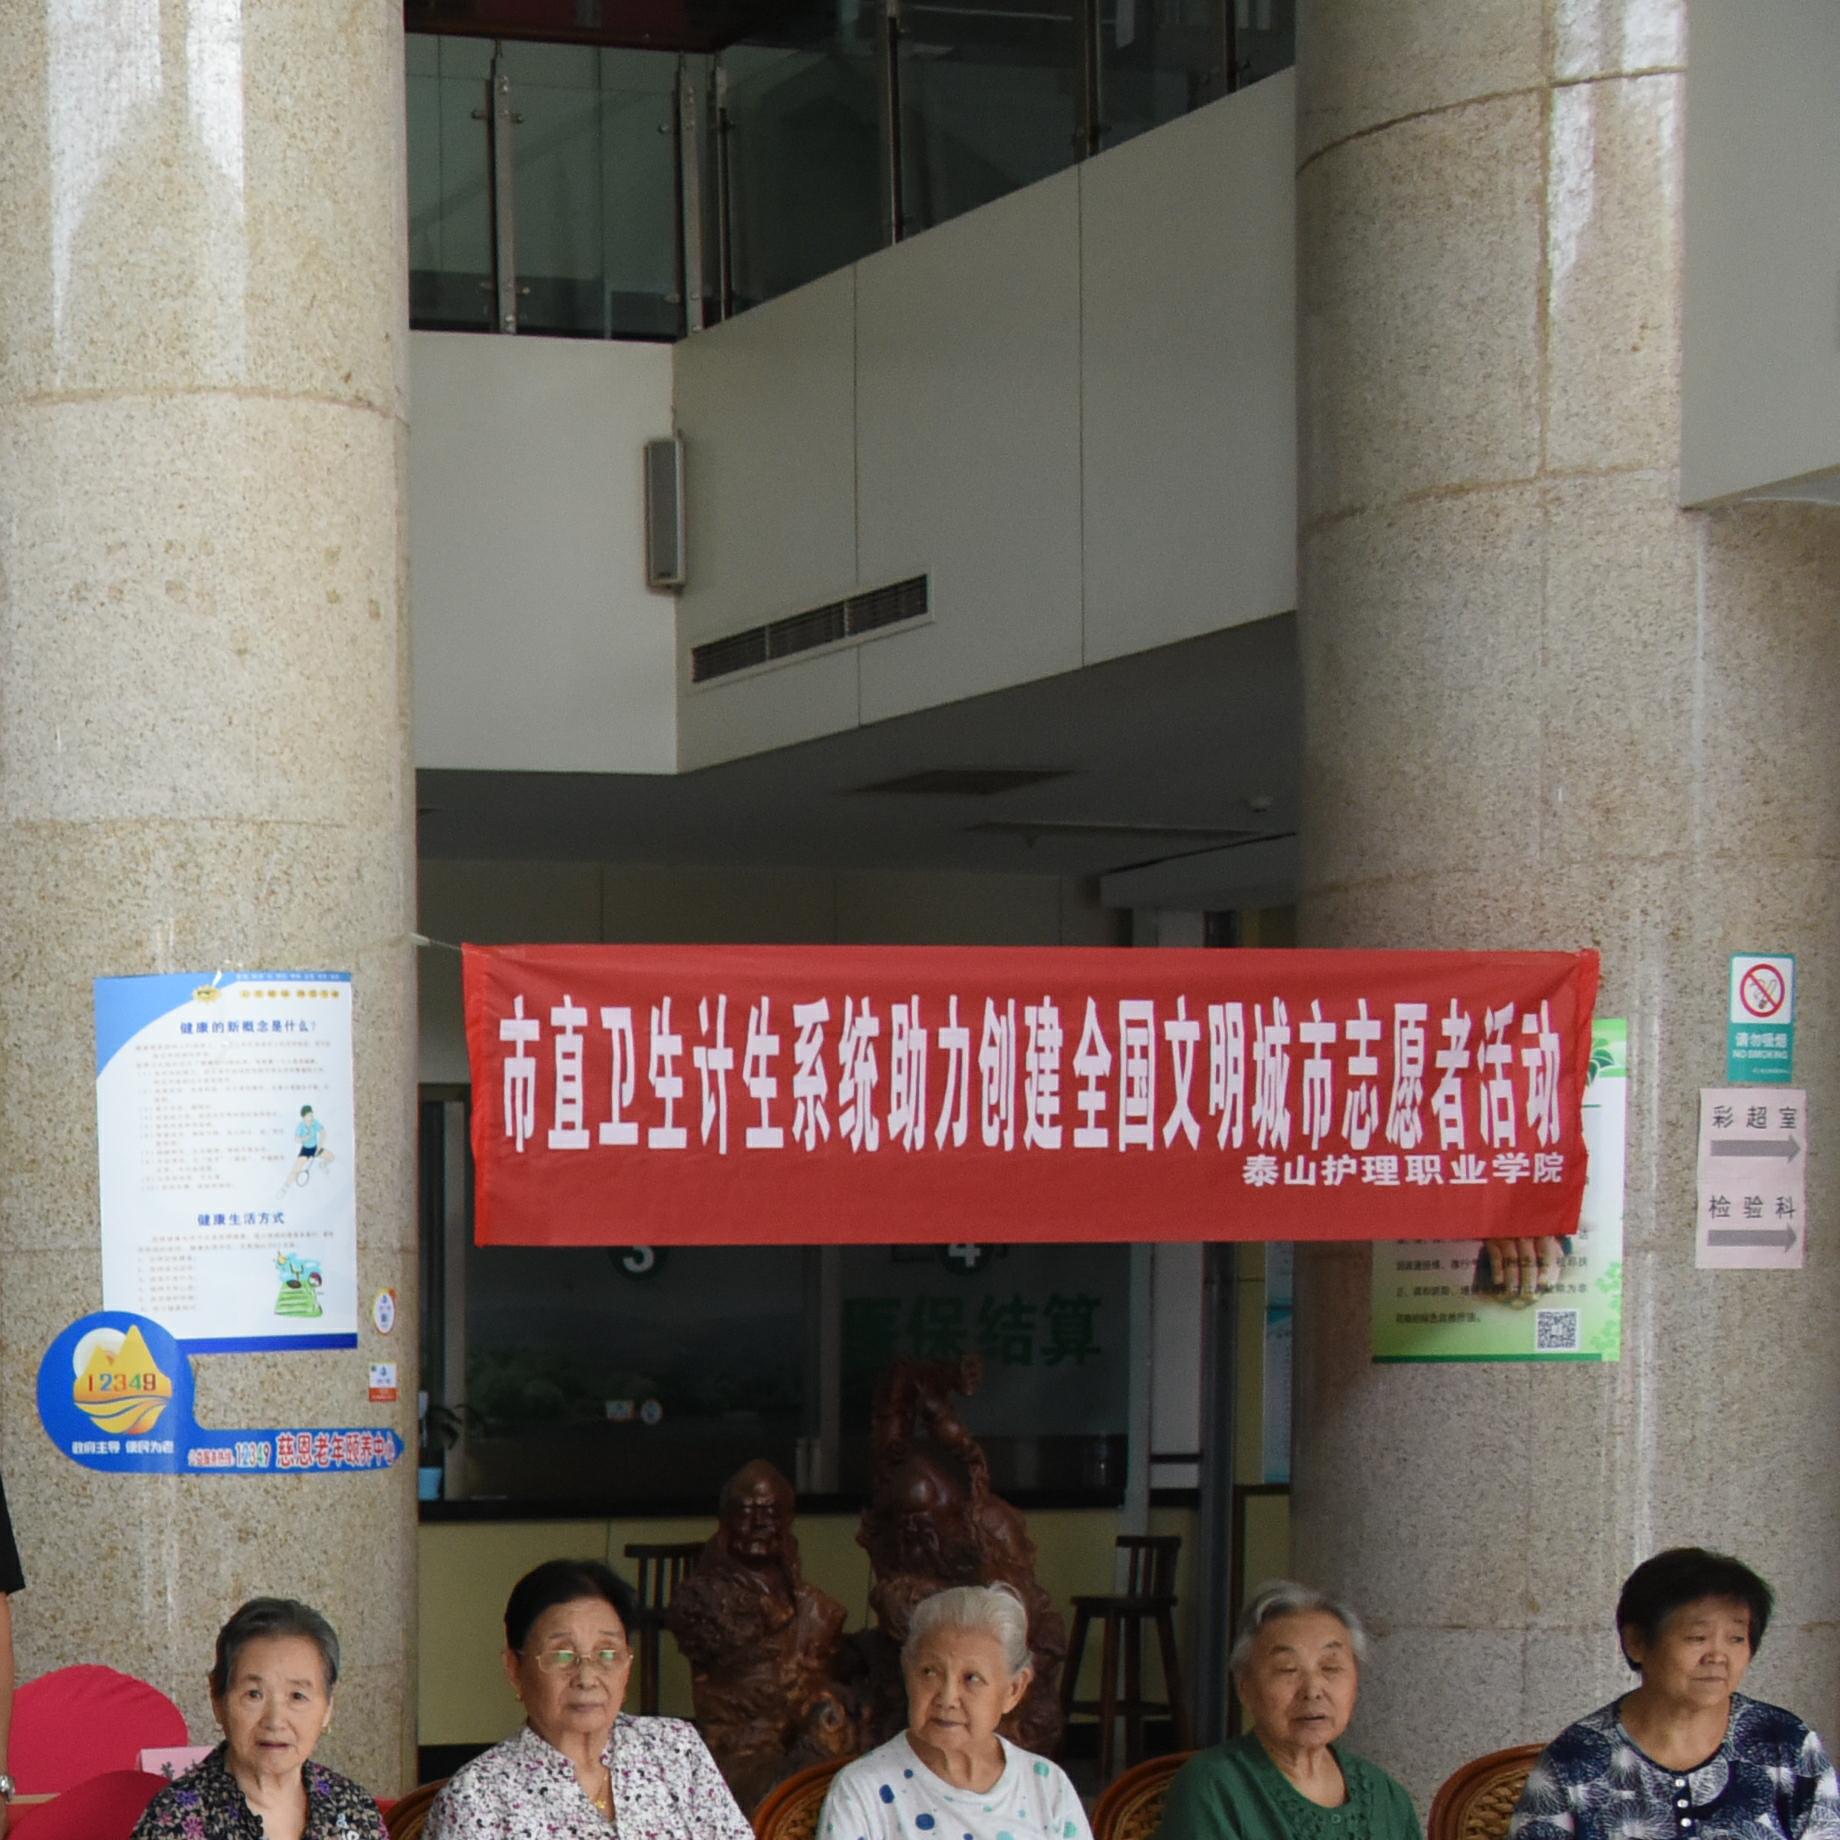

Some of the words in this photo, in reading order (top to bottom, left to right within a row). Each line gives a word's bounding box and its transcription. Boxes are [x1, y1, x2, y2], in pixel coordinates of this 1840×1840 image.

[498, 994, 1561, 1153] 市直卫生计生系统助力创建全国文明城市志愿者活动
[1712, 1105, 1798, 1129] 彩超室
[1241, 1153, 1563, 1187] 泰山护理职业学院
[1708, 1195, 1798, 1220] 检验科
[87, 1372, 157, 1393] 12349
